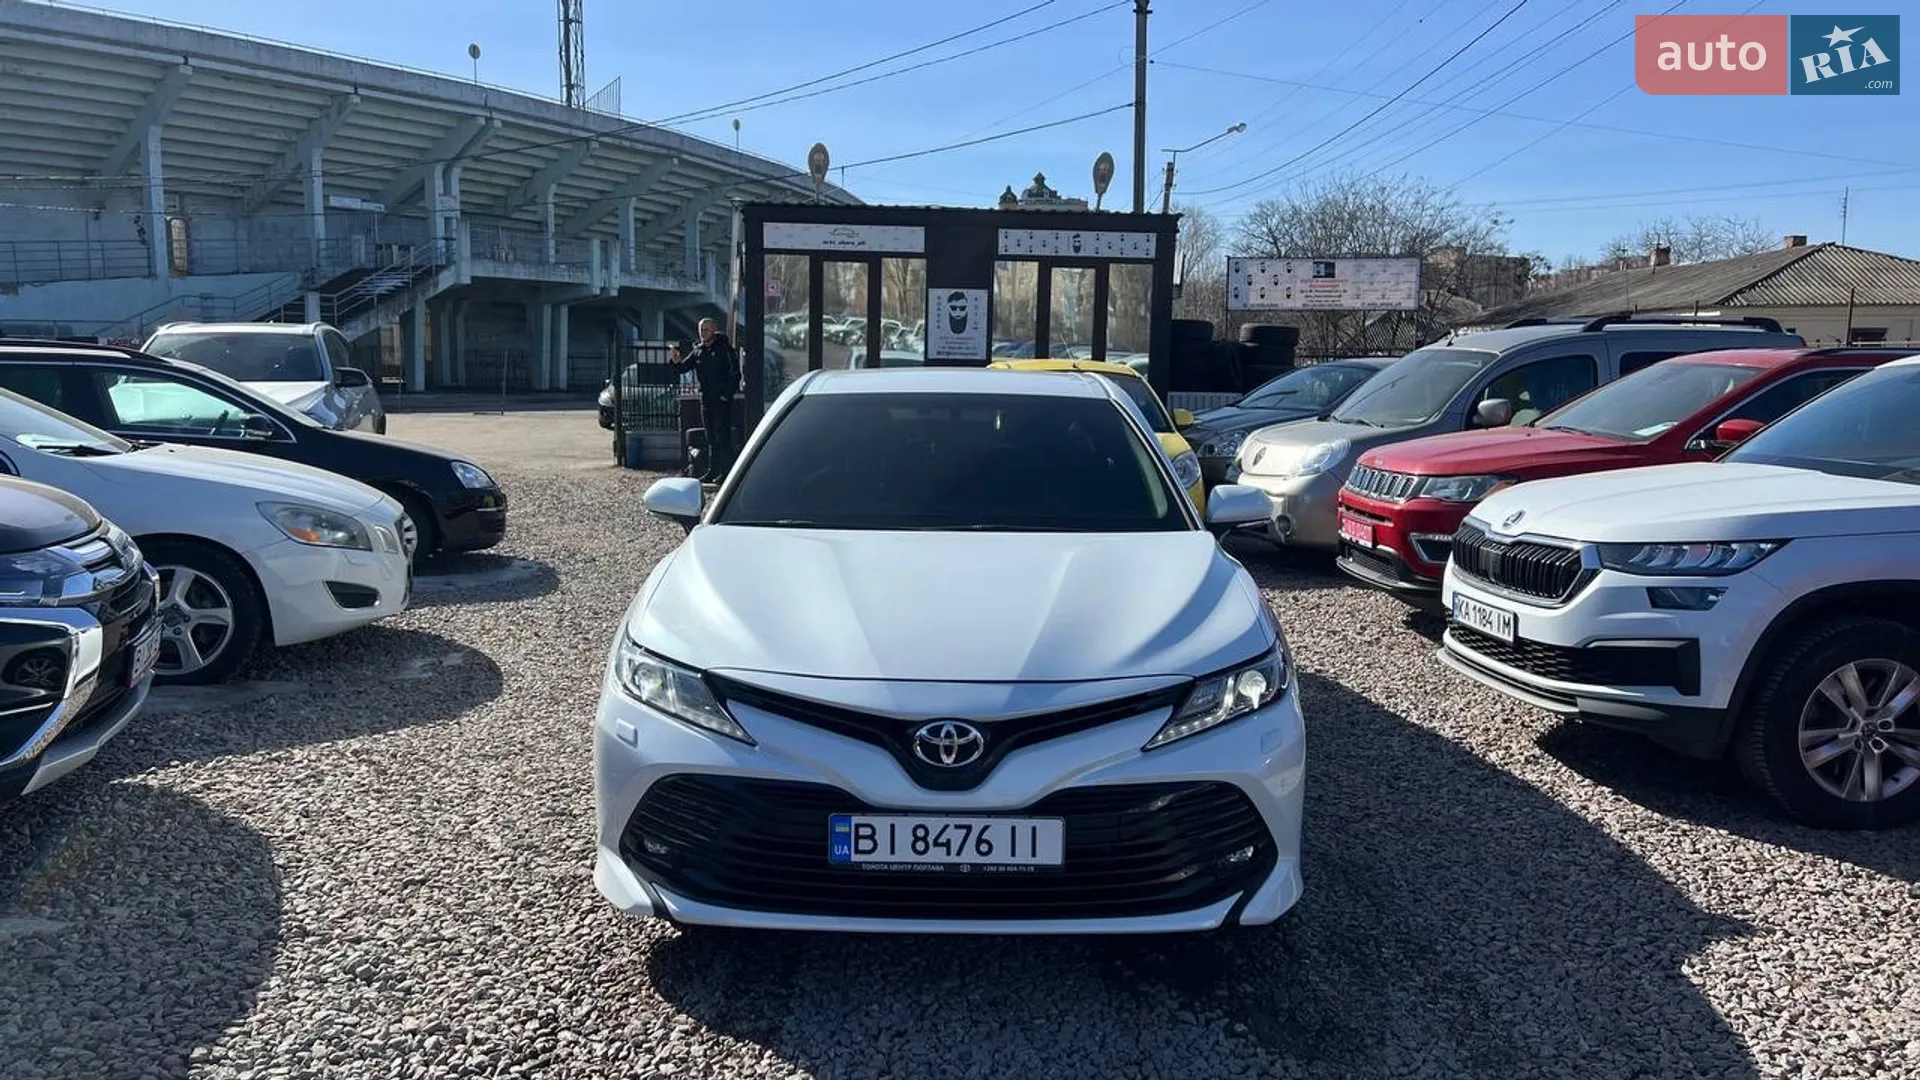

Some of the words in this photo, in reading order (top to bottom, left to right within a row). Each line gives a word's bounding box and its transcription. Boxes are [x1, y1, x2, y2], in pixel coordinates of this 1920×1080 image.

[1472, 604, 1494, 630] 1184
[834, 844, 850, 856] UA
[853, 822, 896, 856] BI
[910, 822, 994, 858] 8476
[1009, 824, 1038, 859] II
